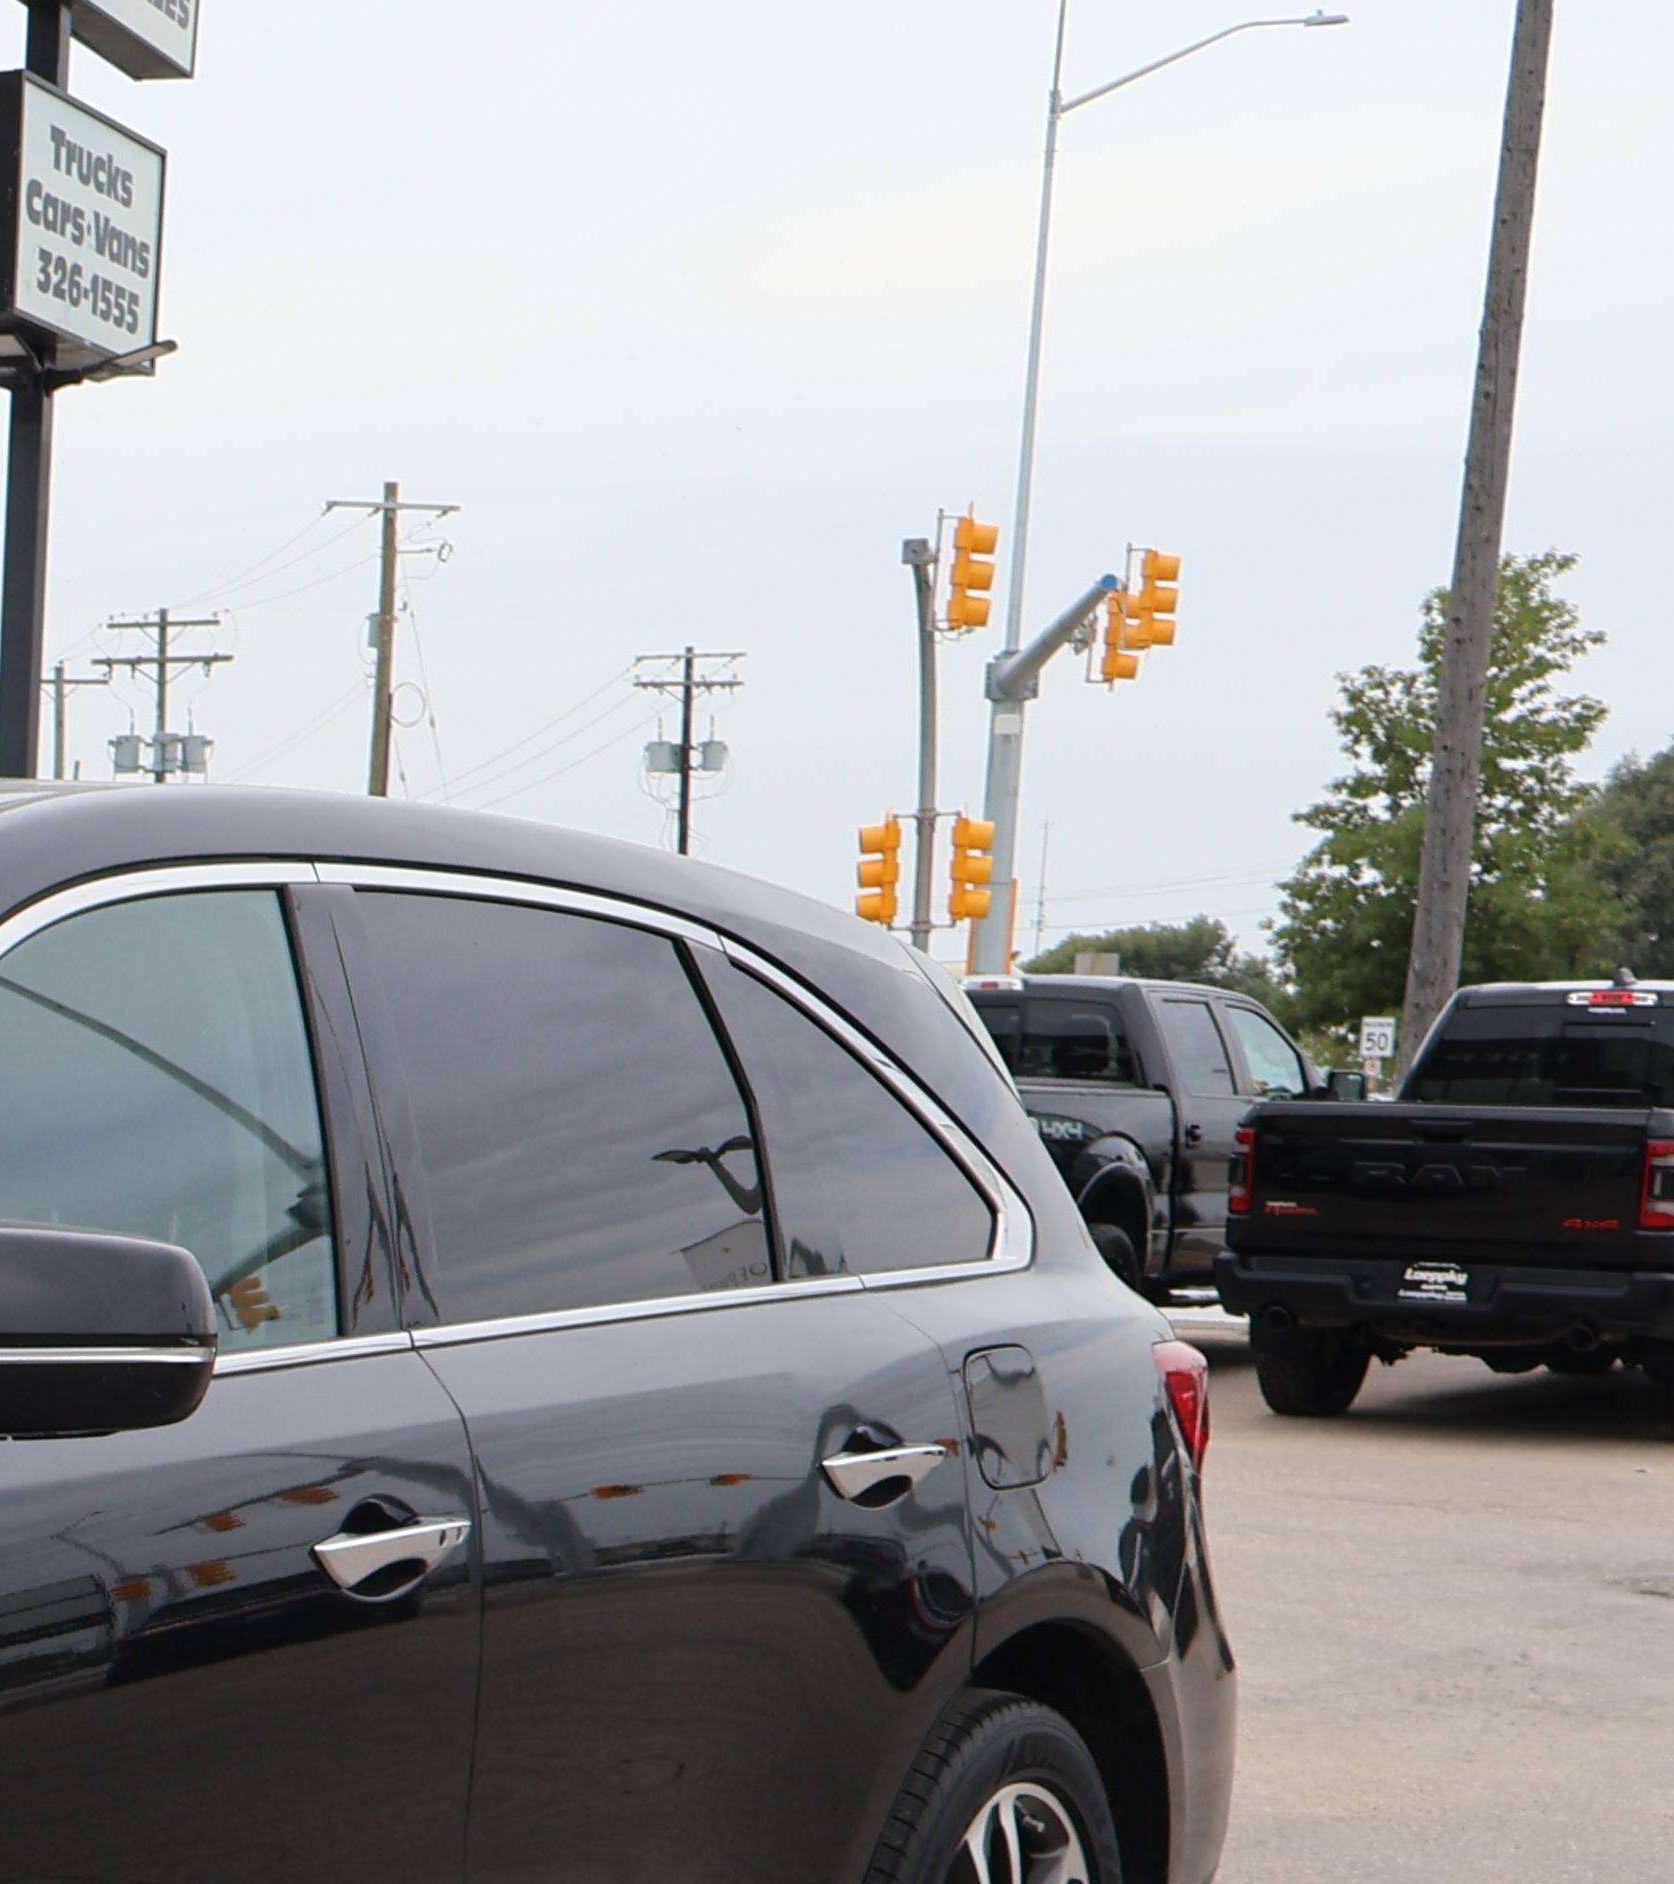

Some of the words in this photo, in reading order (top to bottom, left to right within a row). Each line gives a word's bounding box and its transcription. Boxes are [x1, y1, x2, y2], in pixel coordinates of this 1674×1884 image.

[49, 124, 134, 209] Trucks
[36, 246, 140, 334] 326-1555
[1365, 1032, 1389, 1051] 50
